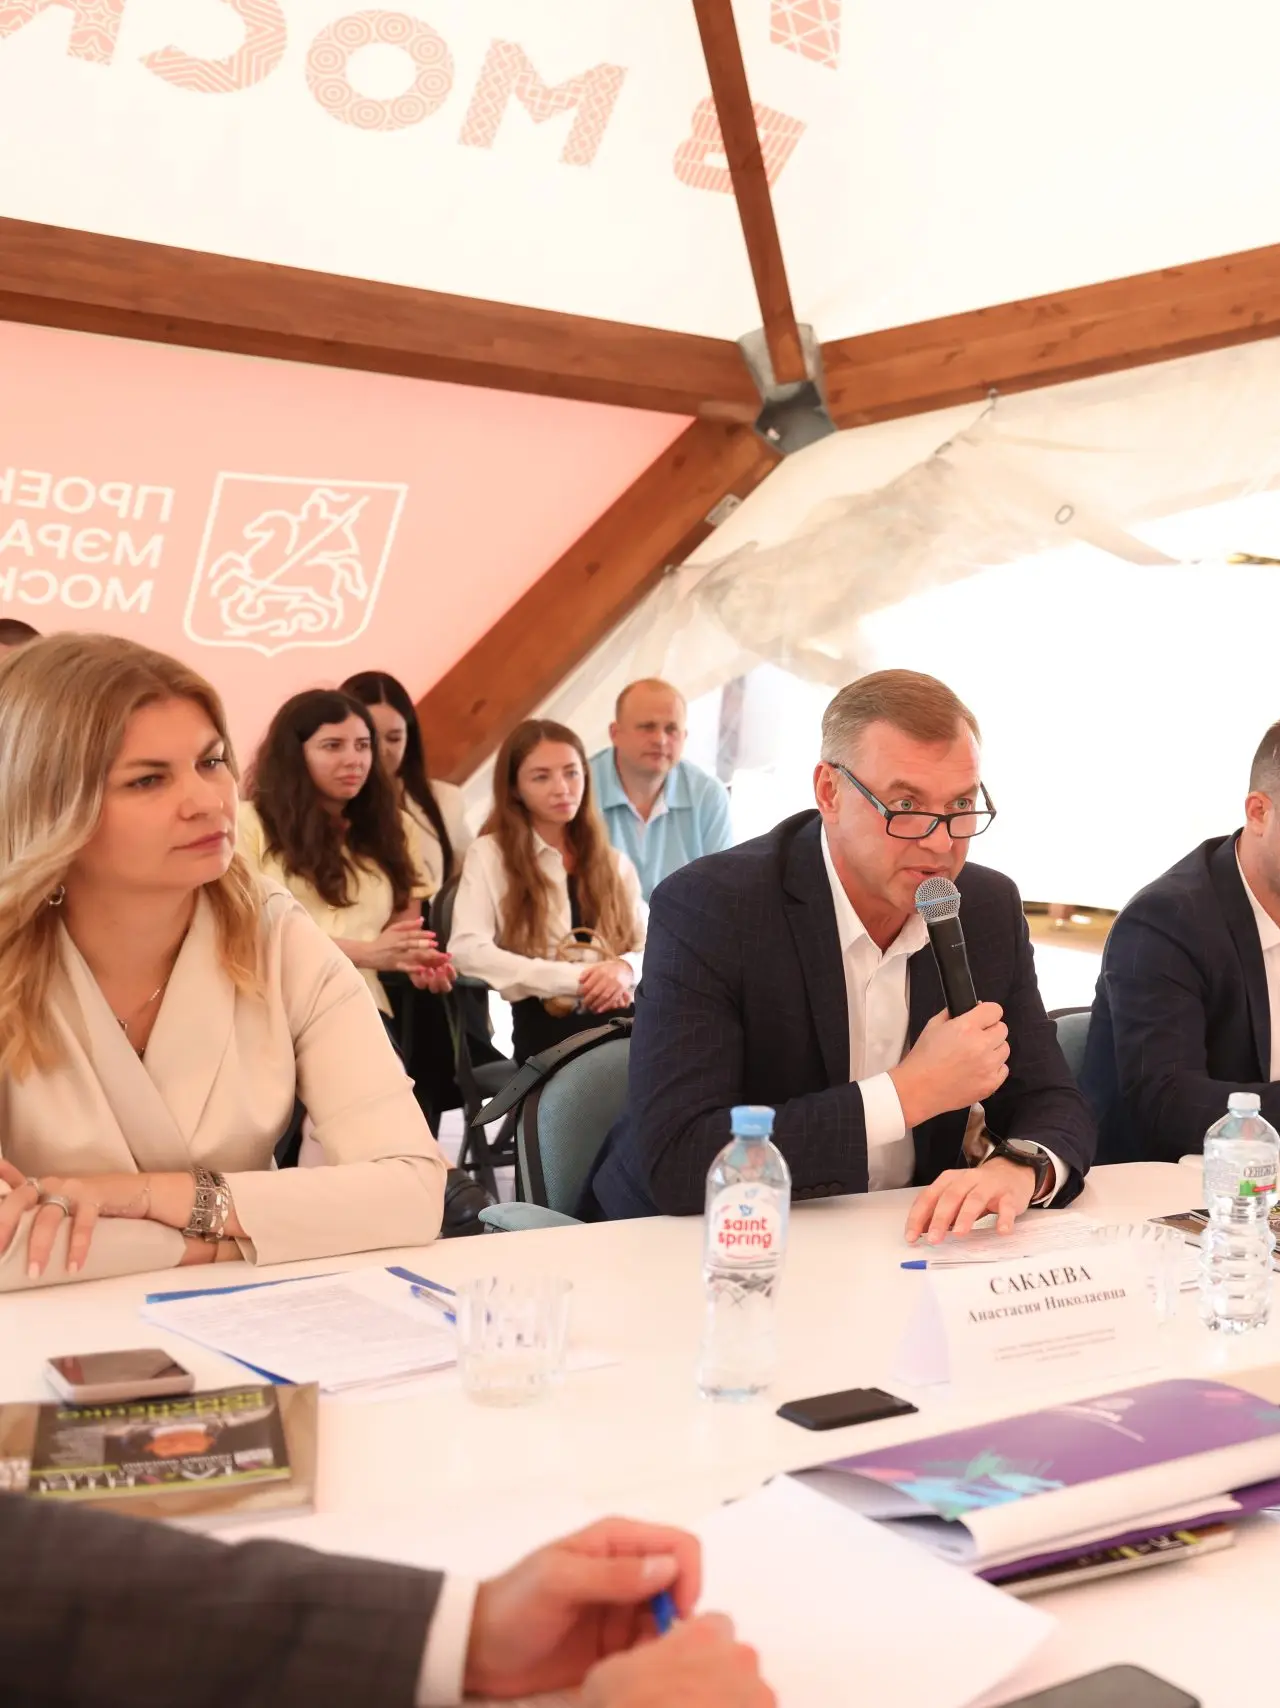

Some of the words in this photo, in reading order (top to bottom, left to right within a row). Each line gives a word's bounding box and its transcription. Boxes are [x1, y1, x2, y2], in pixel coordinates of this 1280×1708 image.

[723, 1216, 767, 1231] saint
[718, 1232, 772, 1249] spring
[989, 1264, 1092, 1296] САКАЕВА
[967, 1300, 1042, 1324] Анастасия
[1046, 1287, 1126, 1311] Николаевна
